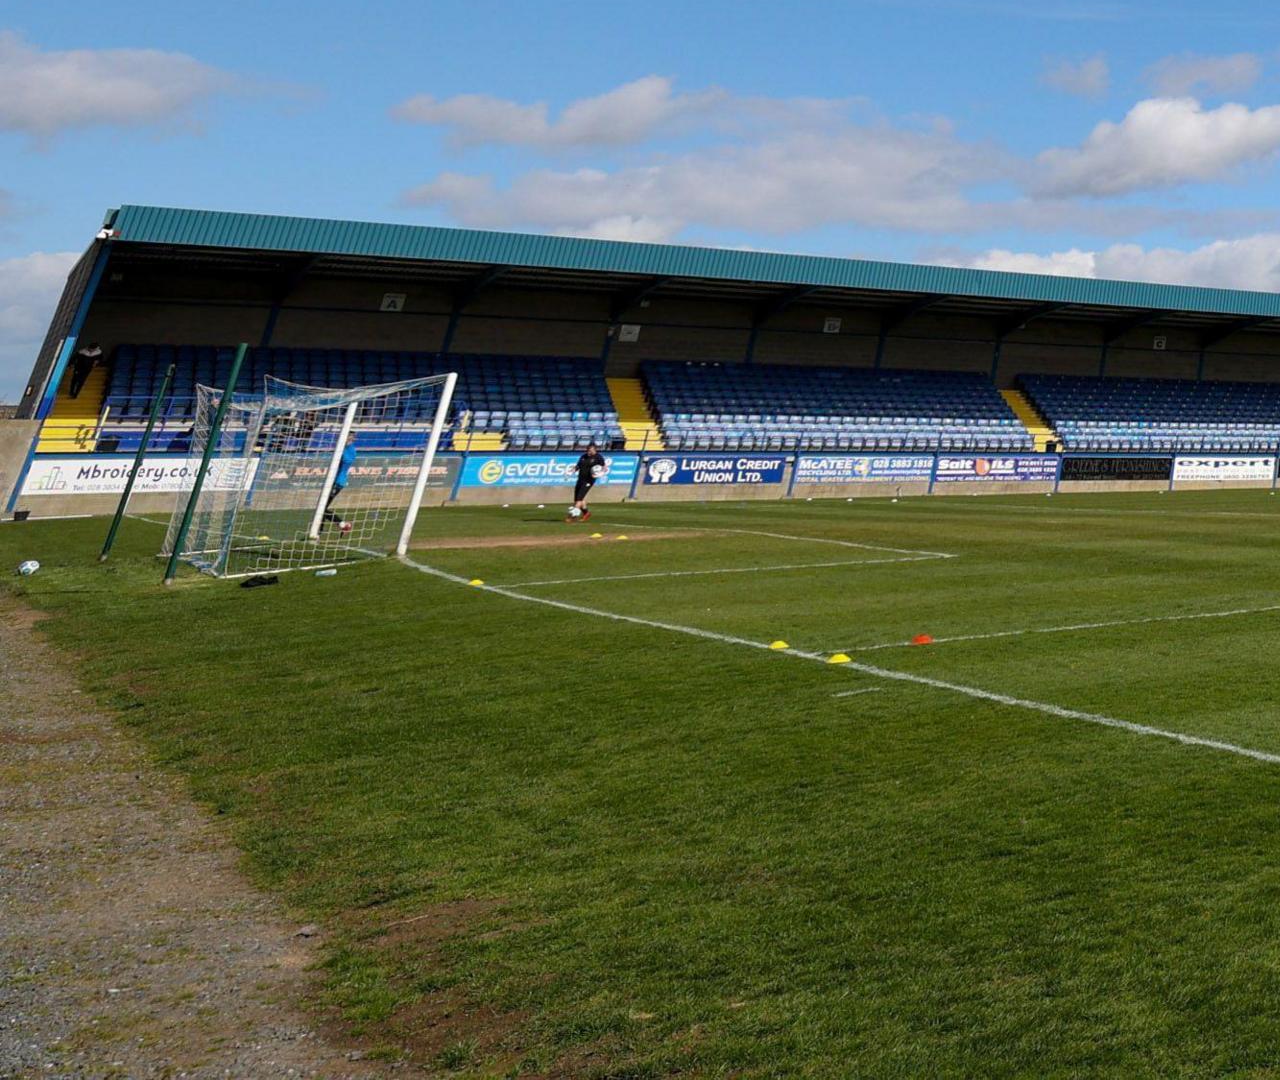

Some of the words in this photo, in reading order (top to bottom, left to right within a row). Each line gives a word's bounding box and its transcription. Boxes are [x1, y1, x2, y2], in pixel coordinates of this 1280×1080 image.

[387, 299, 397, 309] A
[681, 459, 733, 471] LURGAN
[736, 458, 781, 470] CREDIT
[800, 459, 853, 470] McATEE
[938, 459, 974, 469] Salt
[1177, 459, 1272, 468] expert
[693, 471, 734, 482] UNION
[737, 471, 763, 482] LTD.
